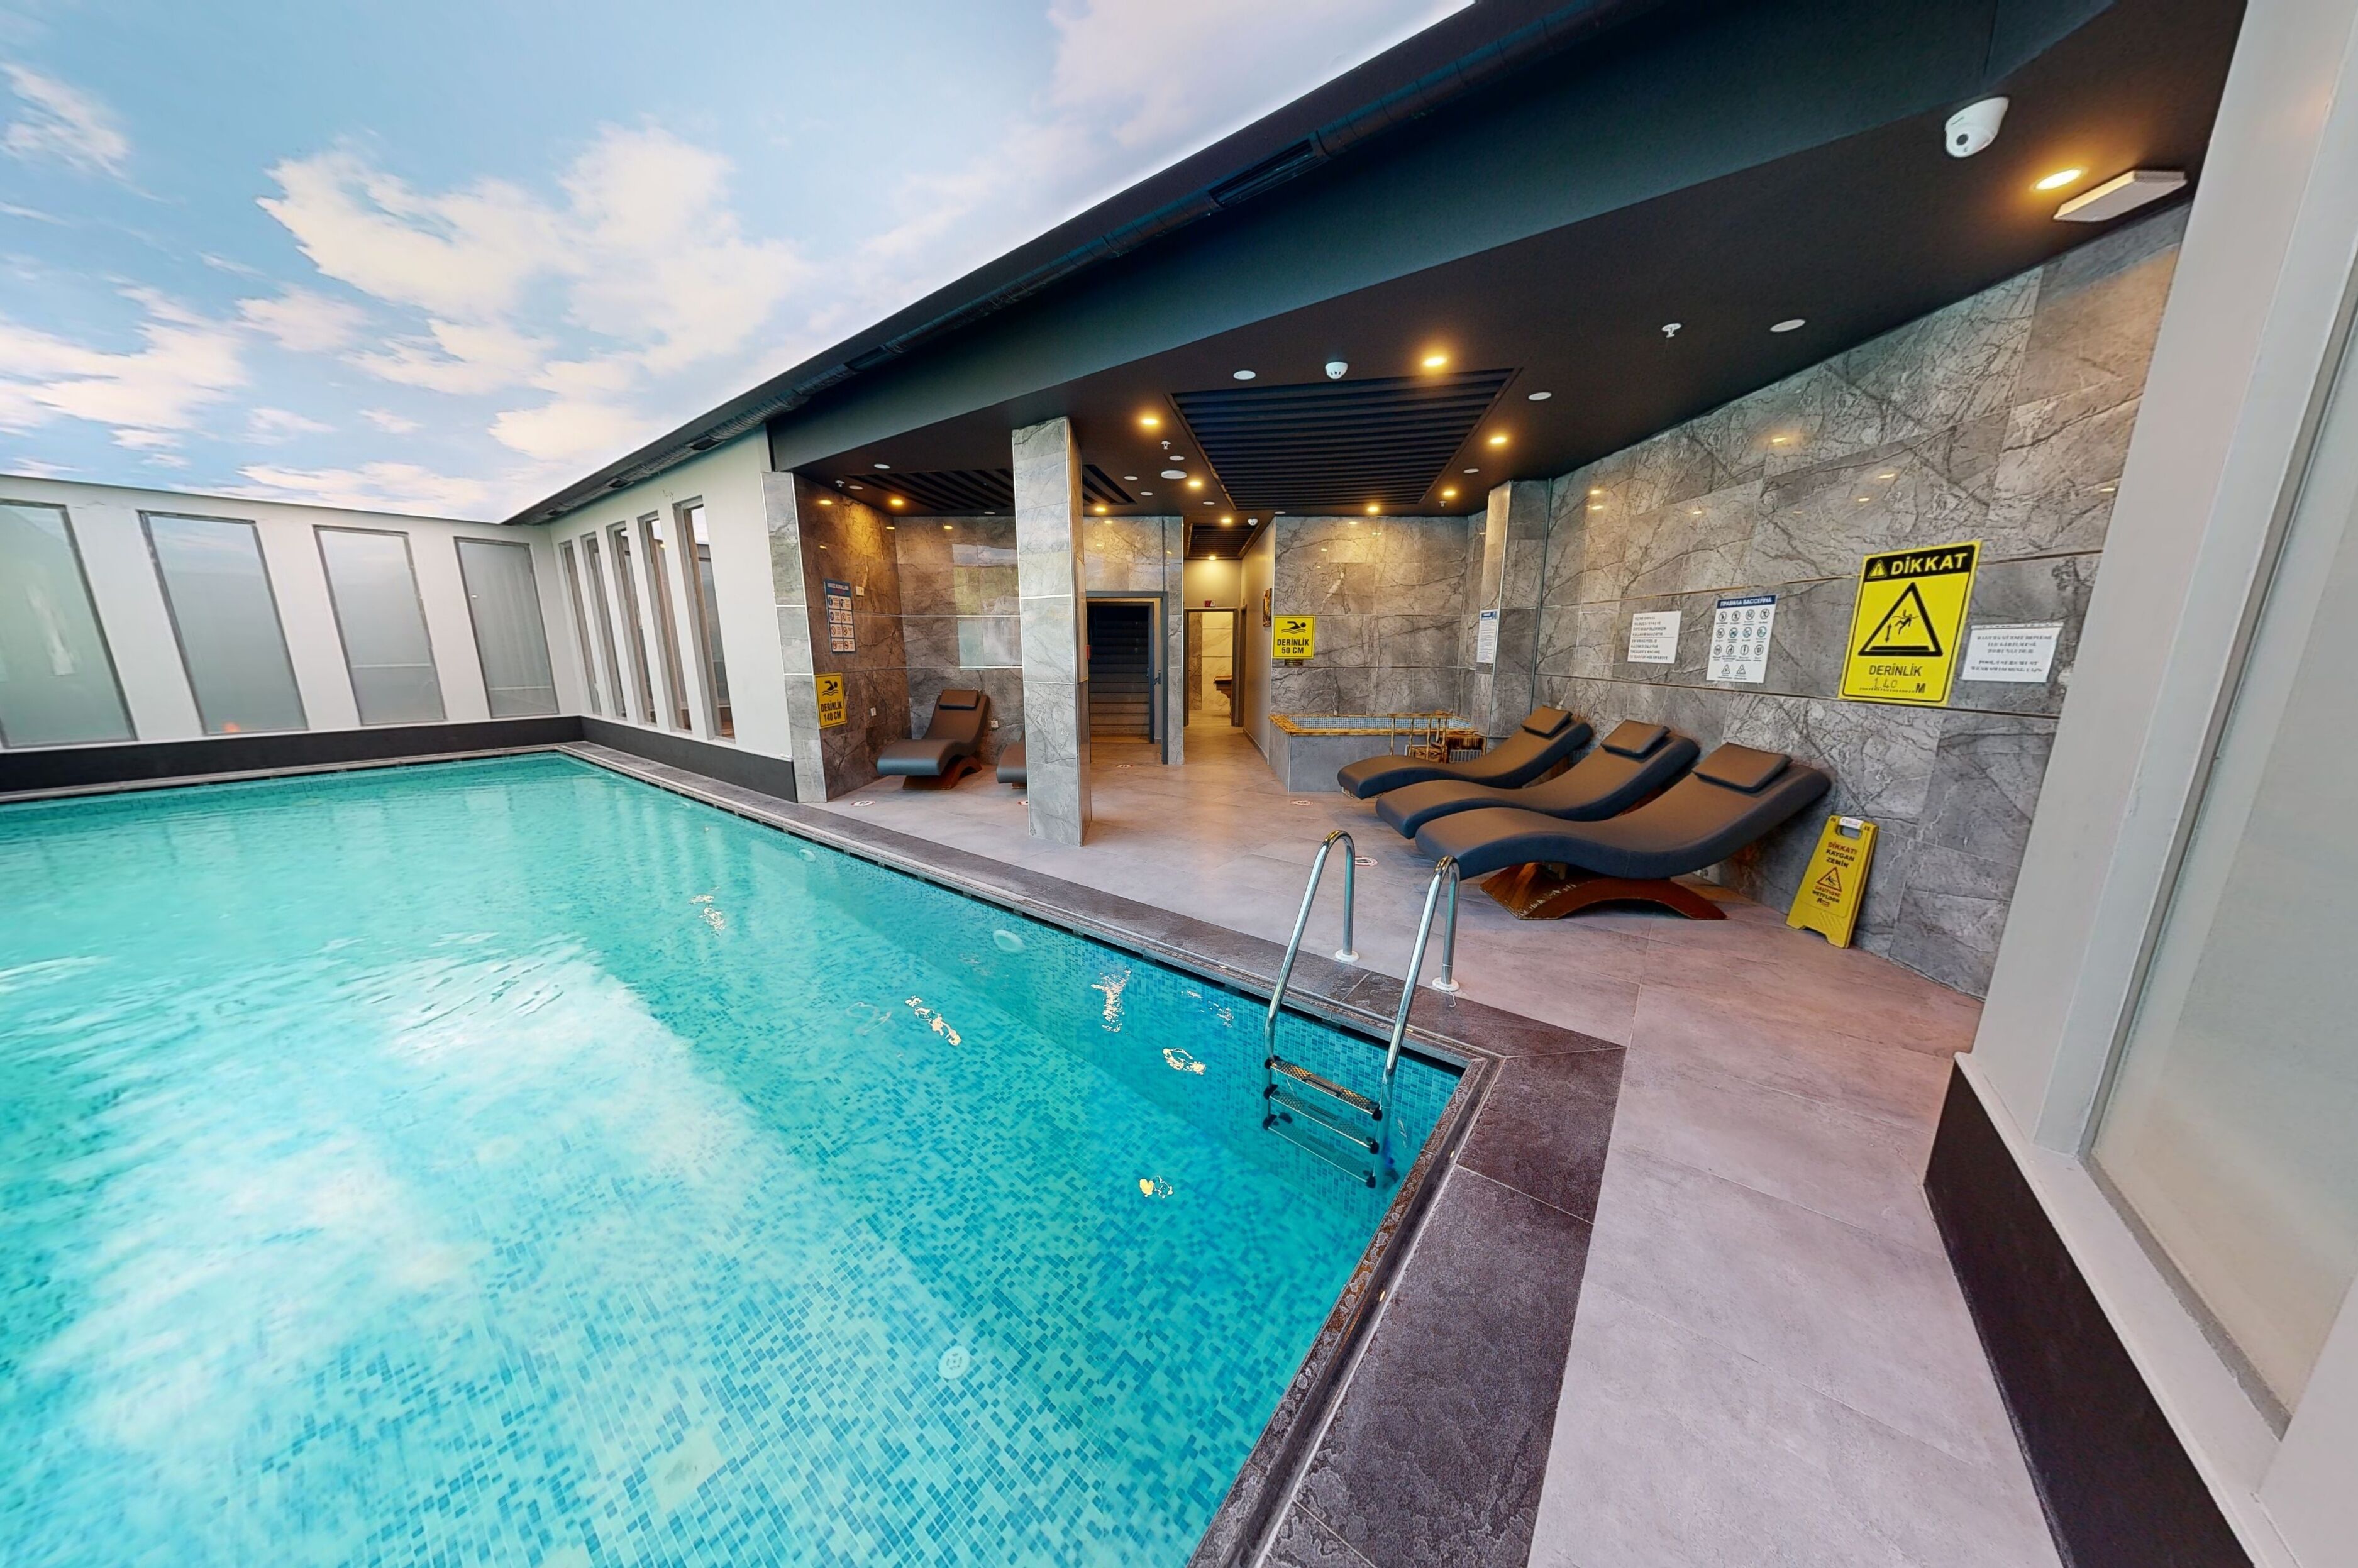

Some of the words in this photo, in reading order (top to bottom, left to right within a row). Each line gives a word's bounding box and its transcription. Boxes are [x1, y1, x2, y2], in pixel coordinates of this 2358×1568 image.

[1890, 553, 1968, 575] DİKKAT
[1277, 637, 1309, 646] DERİNLİK
[1869, 663, 1923, 676] DERİNLİK
[1915, 683, 1925, 693] M
[821, 699, 842, 712] DERİNLİK
[824, 712, 833, 722] 140
[834, 710, 841, 720] CM
[1826, 849, 1855, 861] KAYGAN
[1826, 857, 1849, 868] ZEMİN
